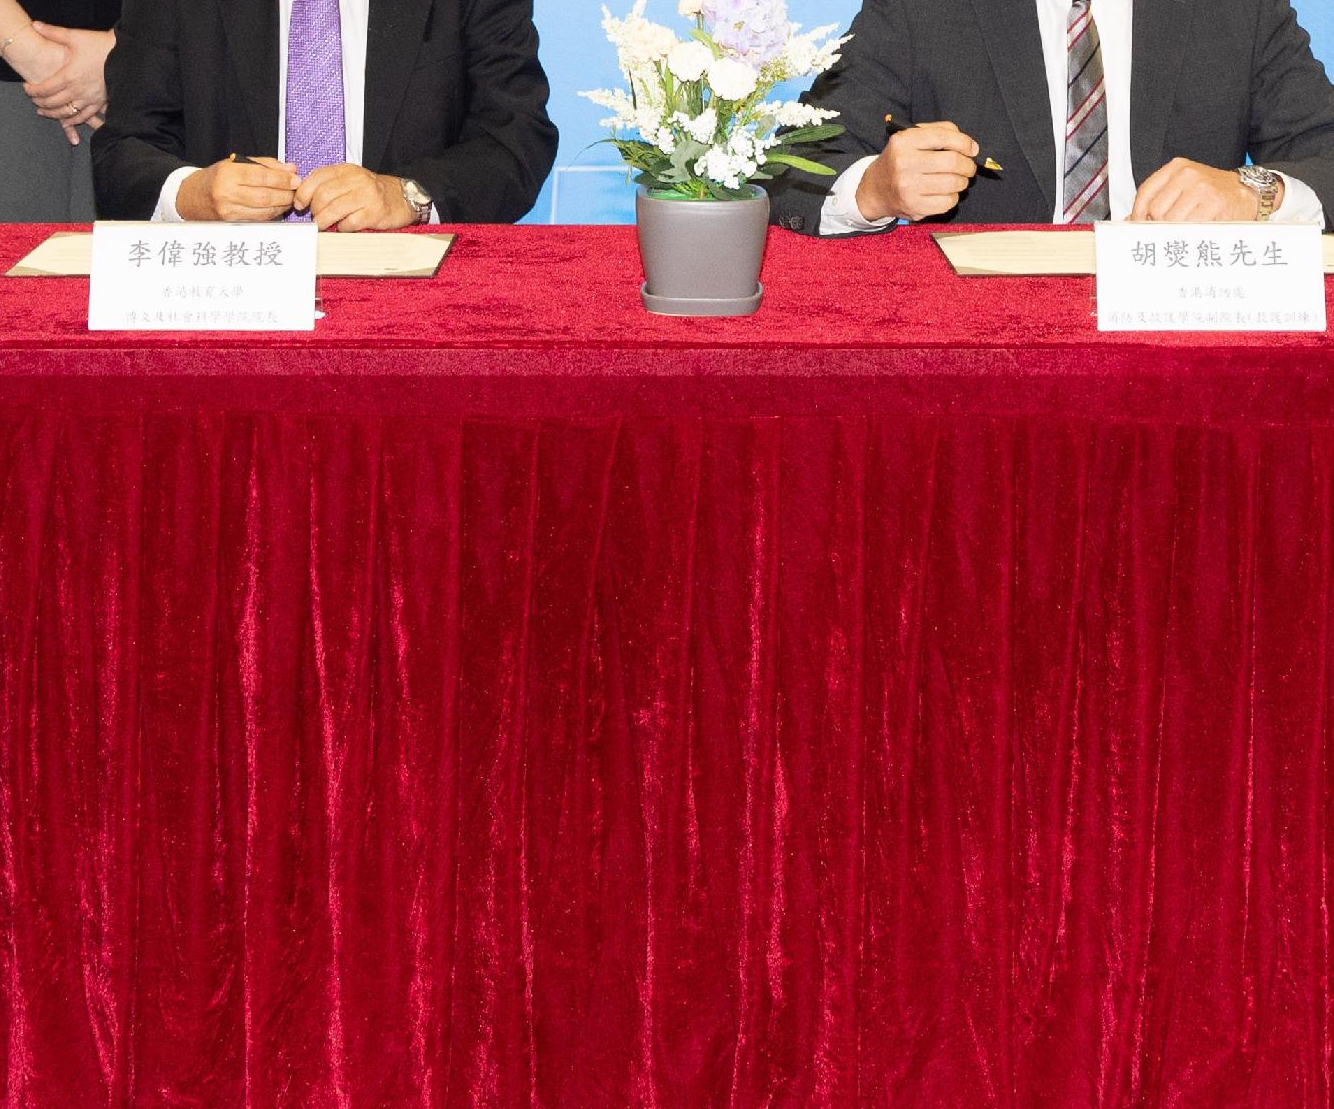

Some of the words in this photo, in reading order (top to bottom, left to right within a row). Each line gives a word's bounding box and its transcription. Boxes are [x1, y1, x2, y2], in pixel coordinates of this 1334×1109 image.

[128, 239, 284, 269] 李偉強教授
